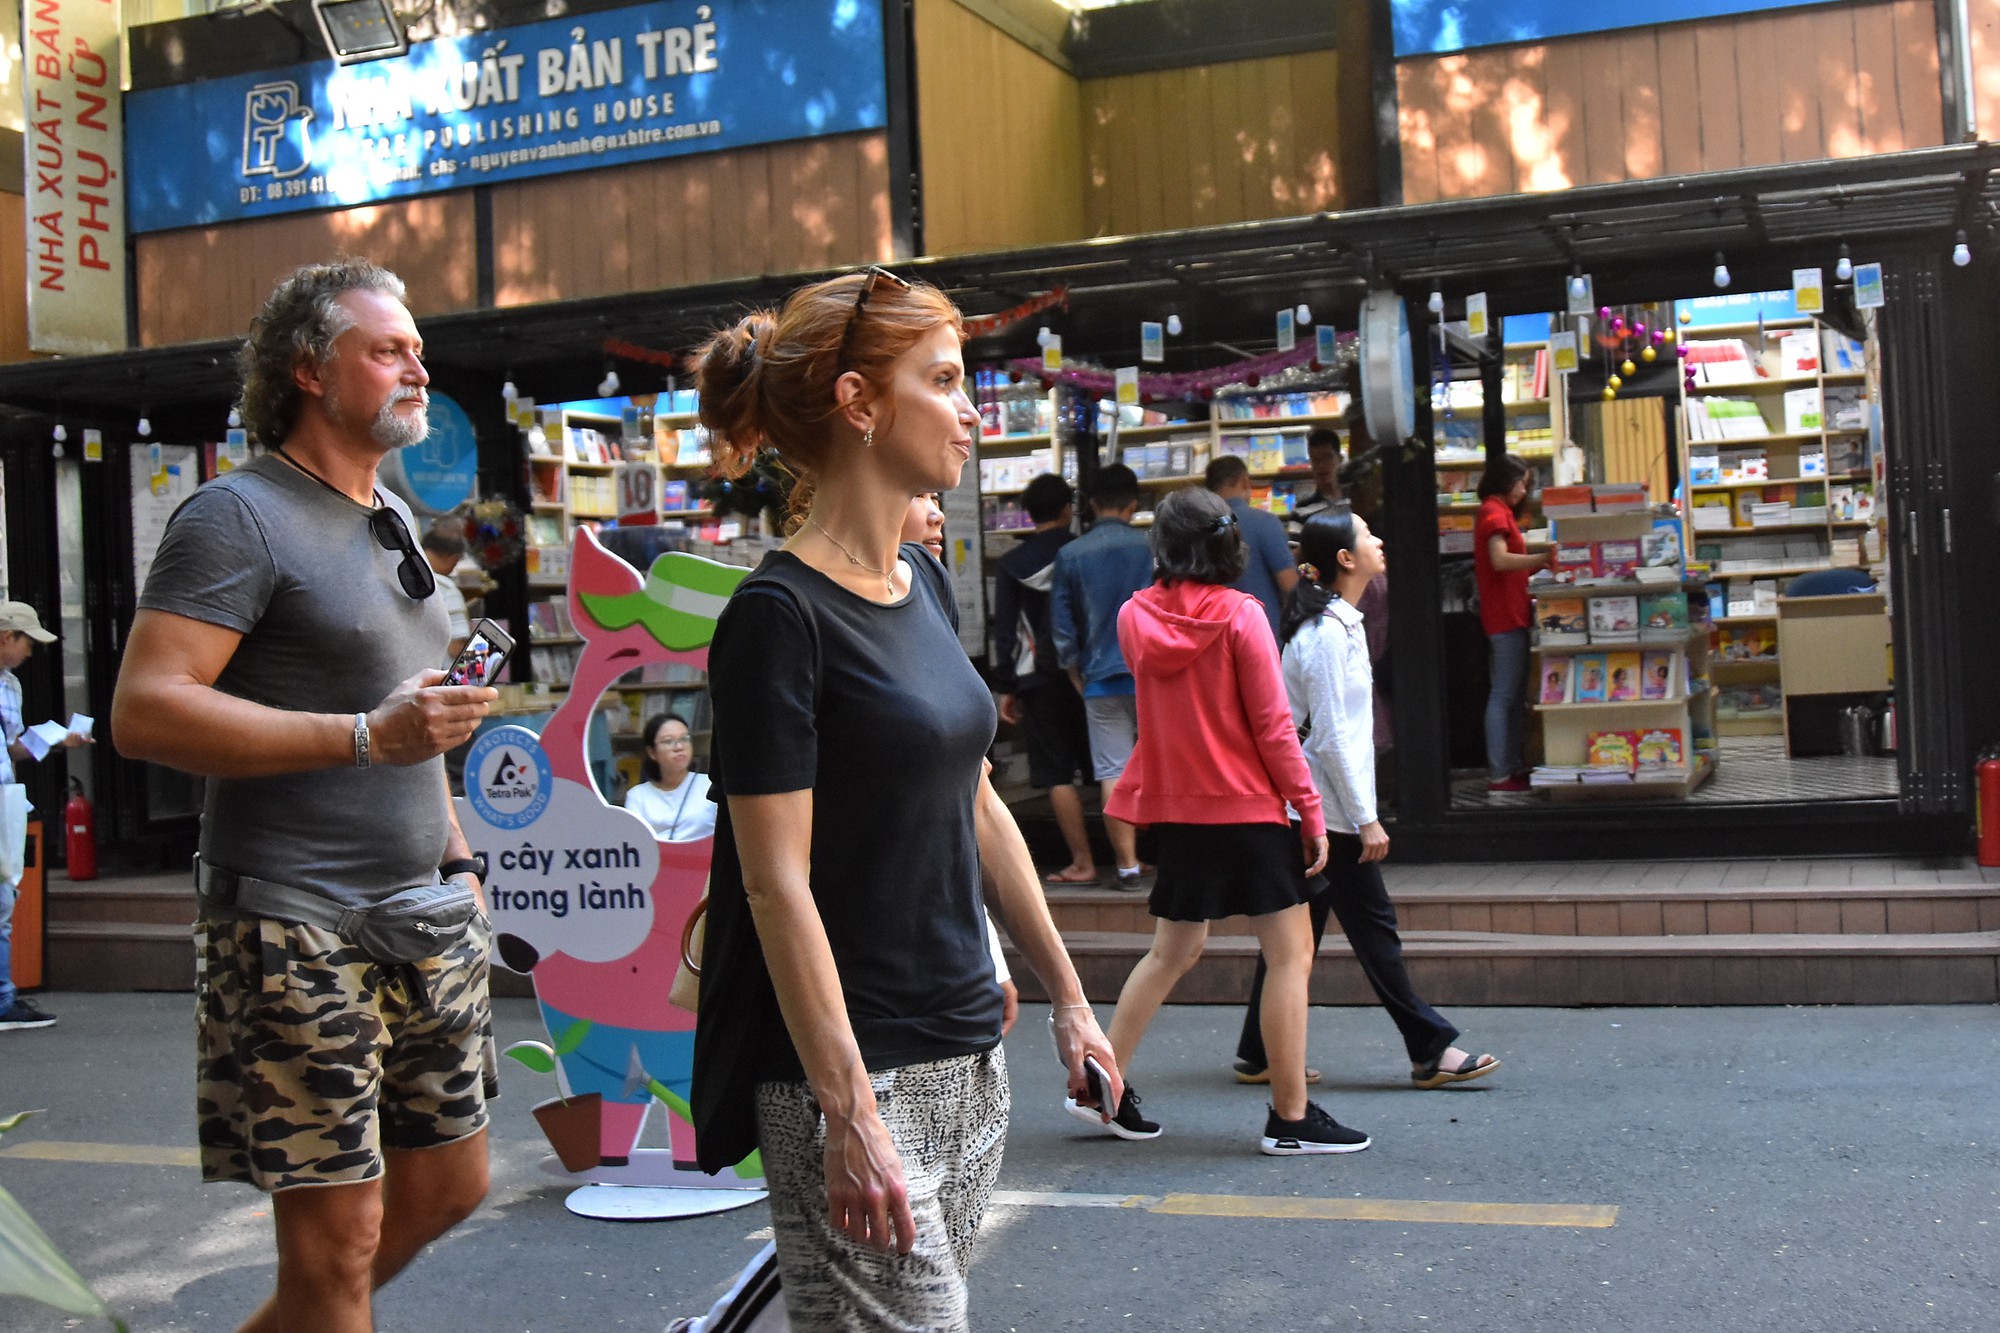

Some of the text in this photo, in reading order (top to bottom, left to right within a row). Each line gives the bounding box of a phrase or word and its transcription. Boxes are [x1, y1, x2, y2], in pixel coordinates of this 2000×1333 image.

[538, 26, 622, 97] BẢN
[636, 5, 718, 79] TRẺ
[424, 107, 579, 150] PUBLISHING
[593, 92, 674, 124] HOUSE
[68, 37, 117, 271] PHỤ NỮ
[33, 210, 65, 292] NHÀ
[620, 469, 652, 508] 10
[478, 731, 538, 755] PROTECTS
[474, 792, 547, 826] WHAT'S GOOD
[486, 788, 511, 798] Tetra
[500, 842, 554, 875] cây
[564, 842, 640, 869] xanh
[491, 880, 645, 917] trong lành
